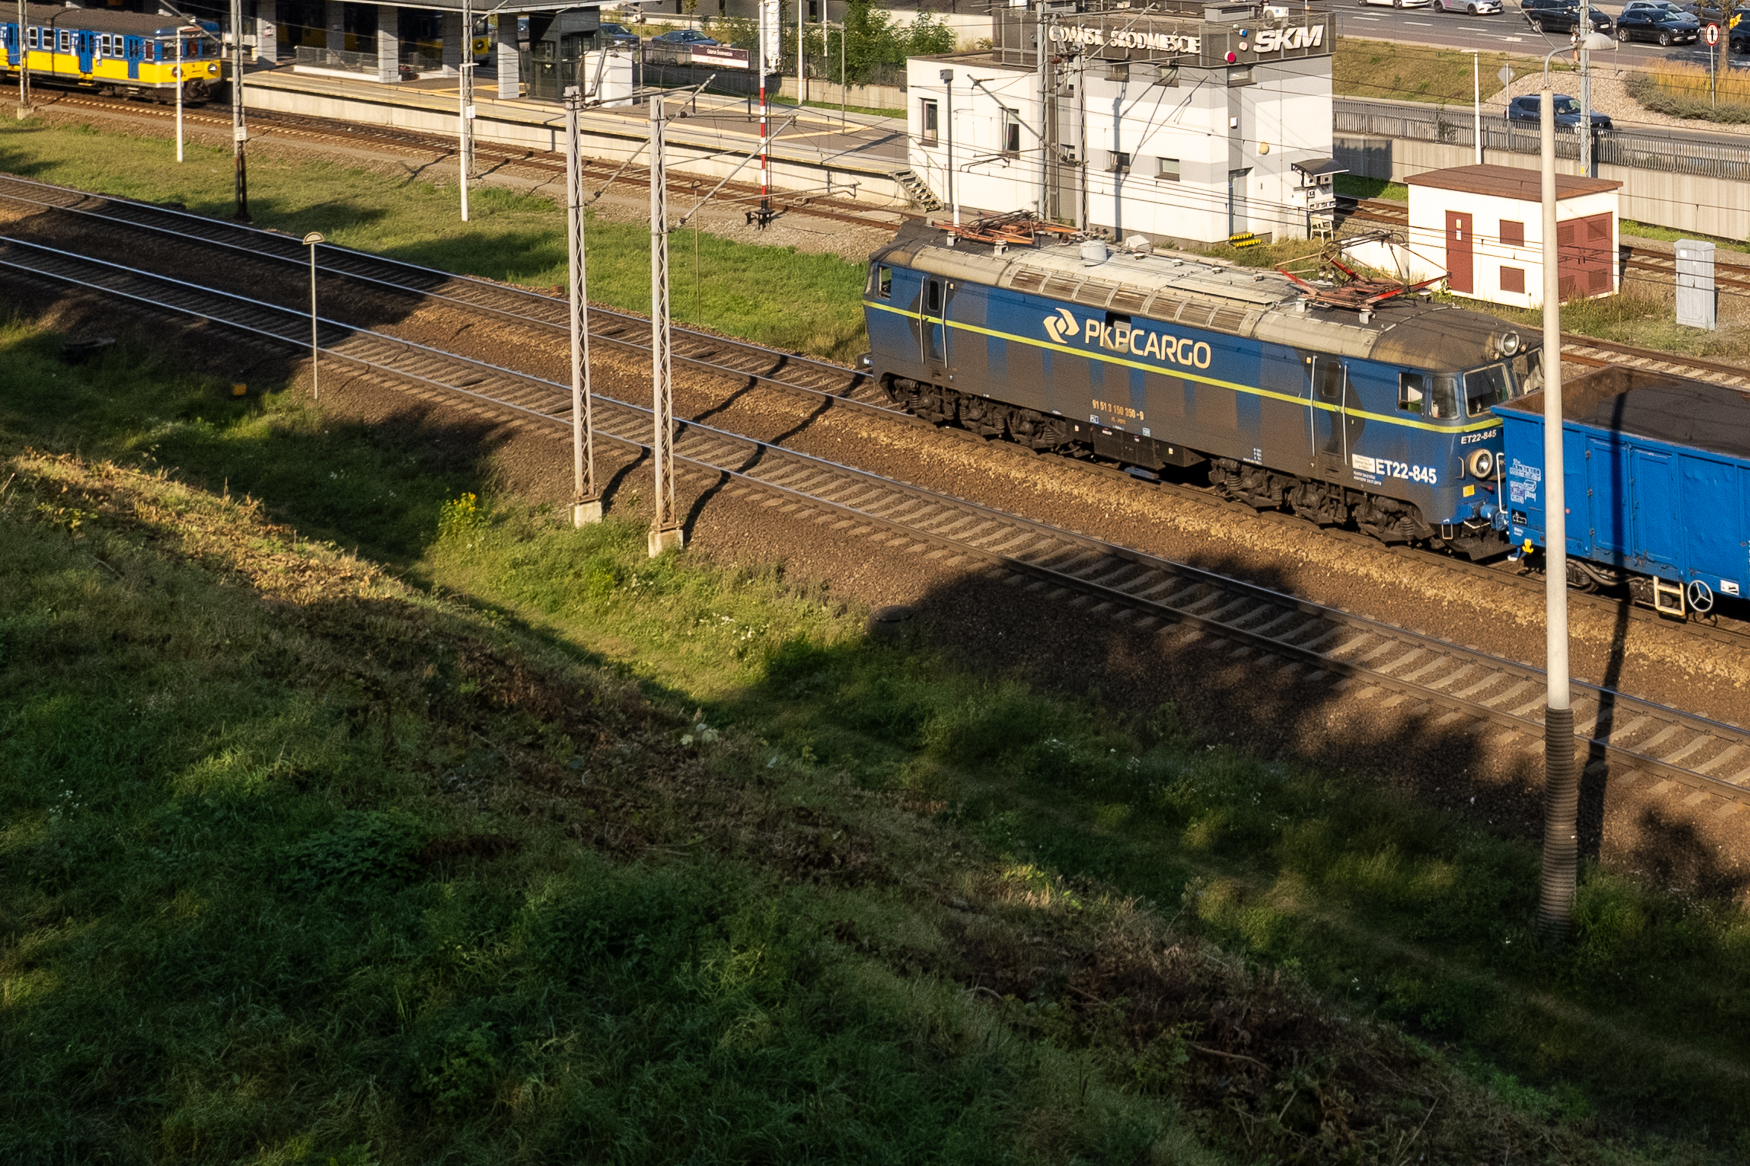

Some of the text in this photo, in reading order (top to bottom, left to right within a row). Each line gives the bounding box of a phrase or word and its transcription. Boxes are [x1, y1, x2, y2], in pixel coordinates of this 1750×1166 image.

[1253, 25, 1324, 53] SKM
[1092, 399, 1099, 409] 91
[1100, 401, 1107, 411] 51
[1460, 429, 1497, 444] ET22-845
[1375, 458, 1437, 484] ET22-845
